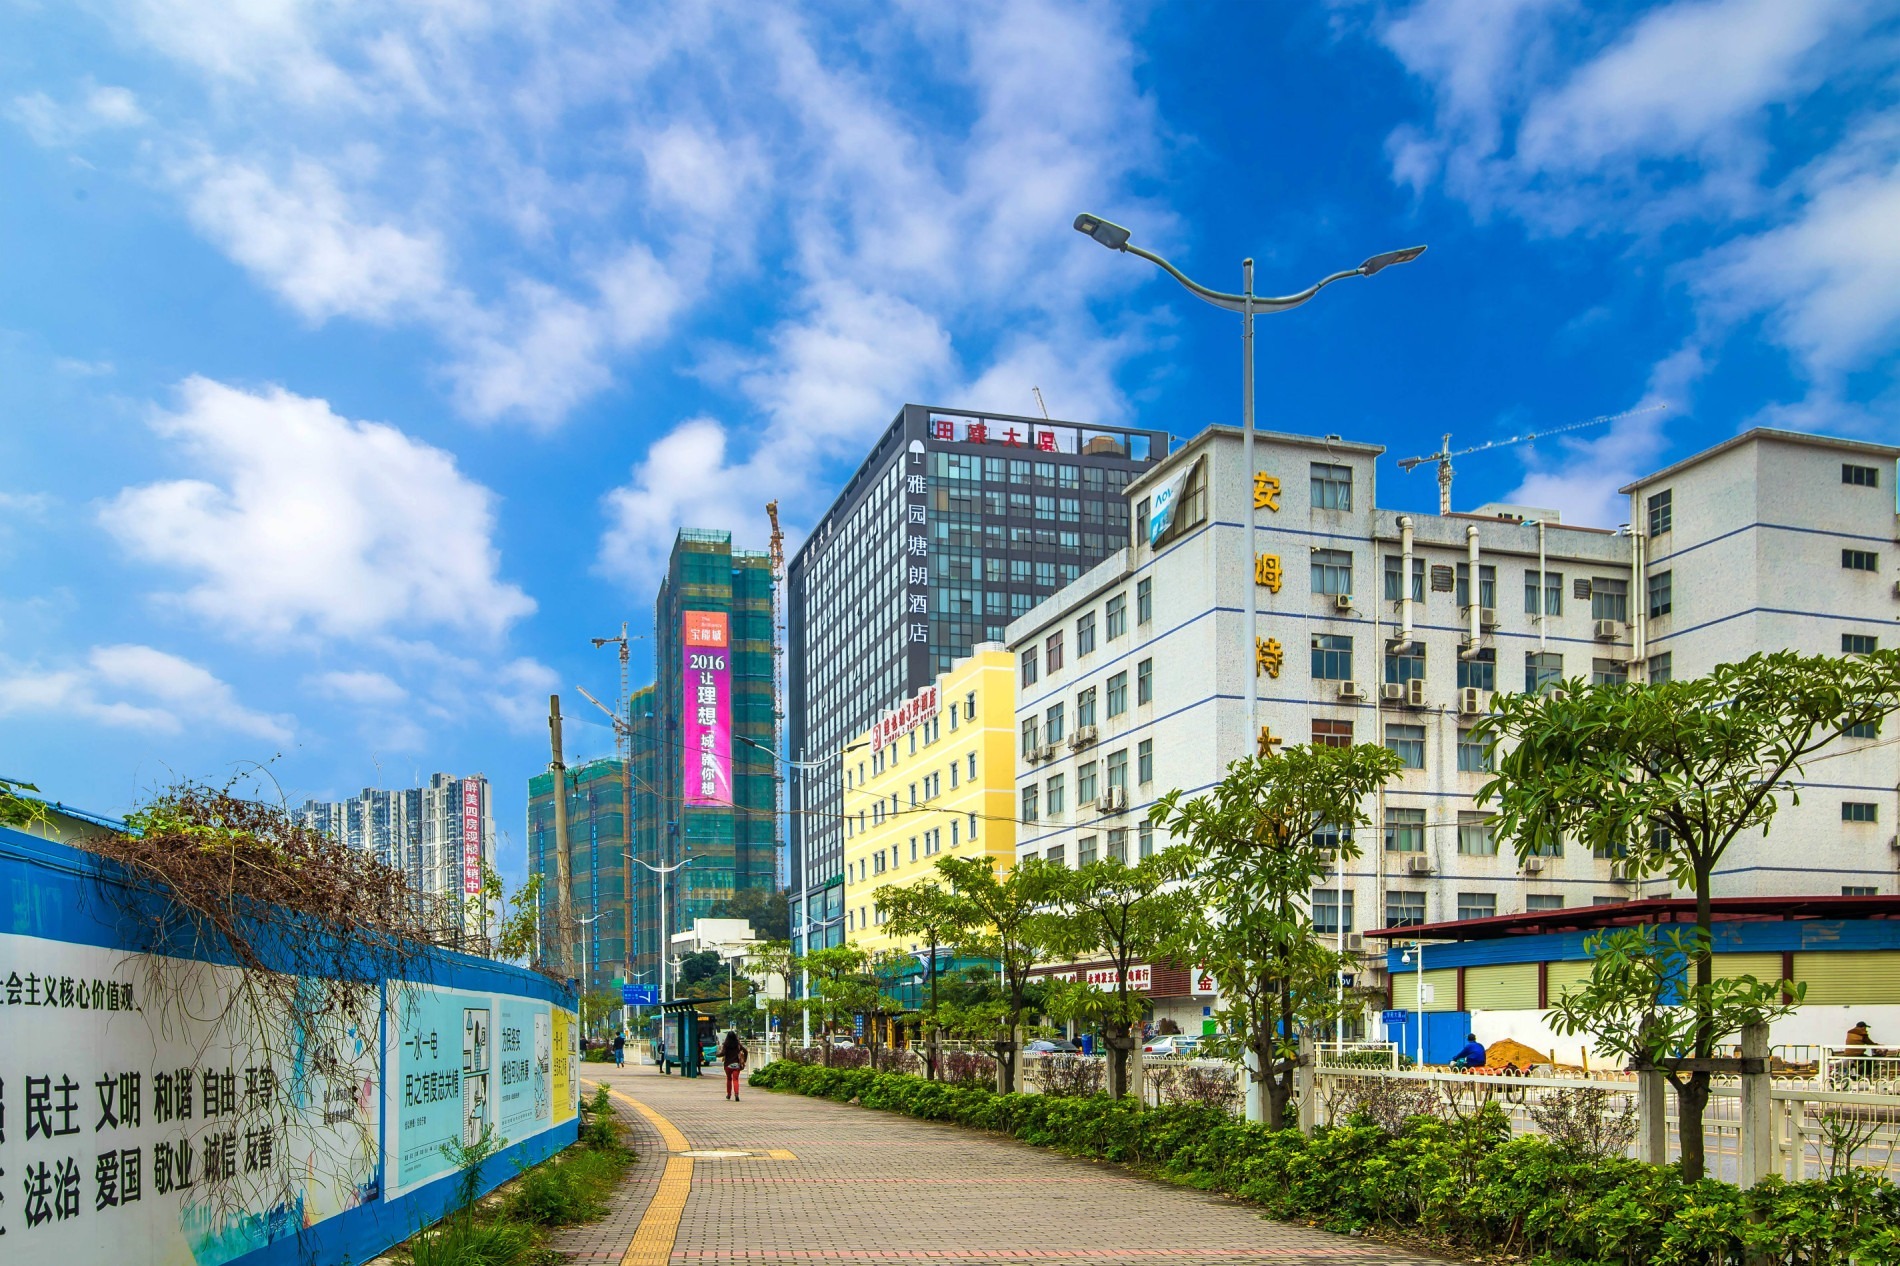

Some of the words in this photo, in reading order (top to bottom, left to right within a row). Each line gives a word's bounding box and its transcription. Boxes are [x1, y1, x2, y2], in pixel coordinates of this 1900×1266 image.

[907, 474, 928, 643] 雅园塘朗酒店
[690, 628, 722, 641] 宝能城
[690, 654, 725, 670] 2016
[0, 971, 133, 1011] 会主义核心价值观
[405, 1027, 437, 1061] 一水一电
[25, 1073, 80, 1142] 民主
[95, 1071, 141, 1133] 文明
[153, 1068, 193, 1124] 和谐
[203, 1066, 236, 1119] 自由
[244, 1066, 273, 1111] 平等
[405, 1068, 459, 1108] 用之有度总关情
[24, 1156, 81, 1230] 法治
[95, 1146, 142, 1213] 爱国
[153, 1138, 193, 1195] 敬业
[203, 1131, 236, 1182] 诚信
[244, 1124, 273, 1175] 友善
